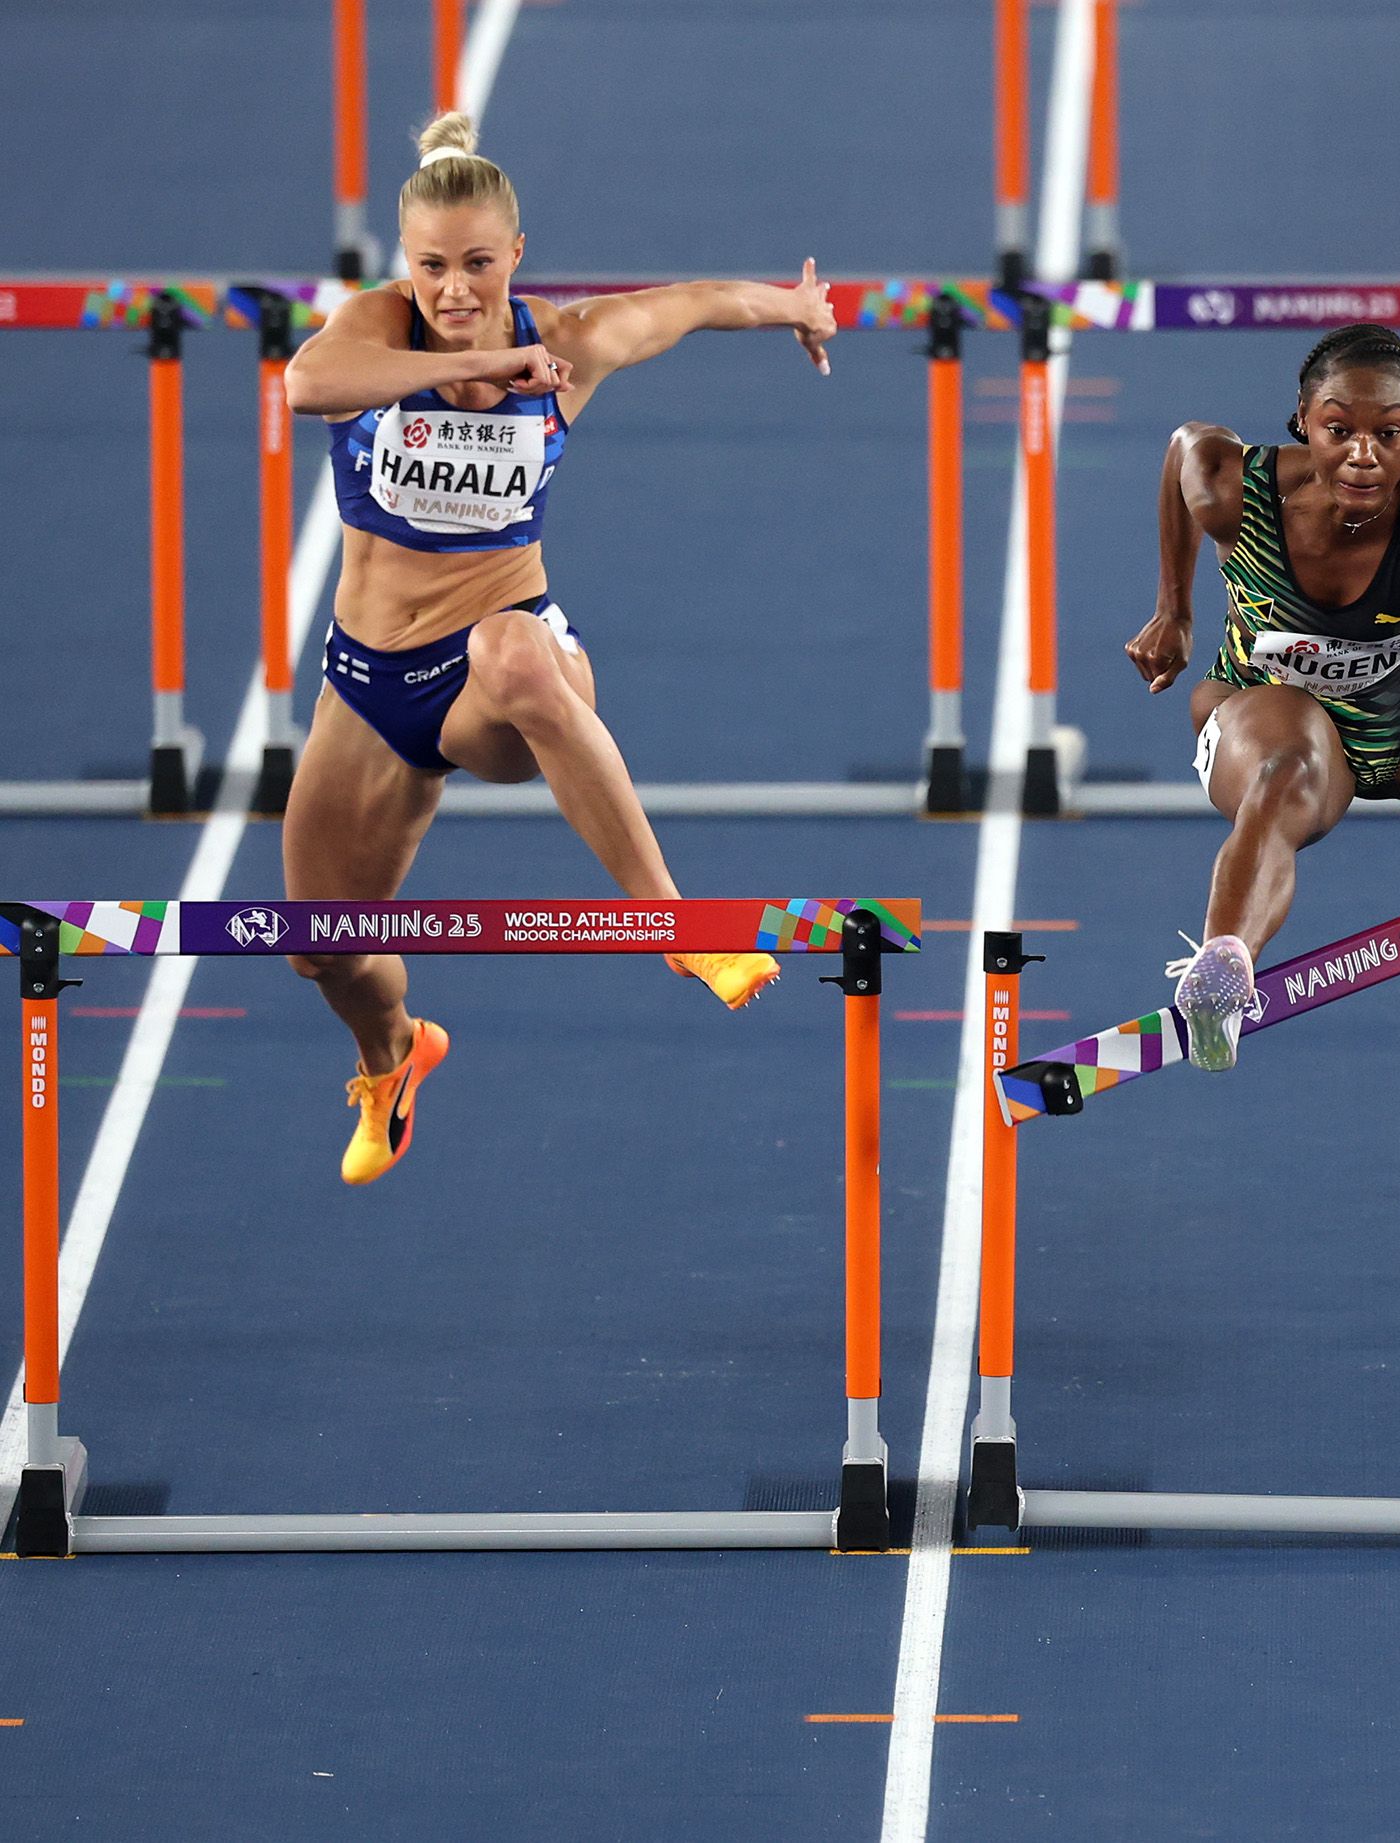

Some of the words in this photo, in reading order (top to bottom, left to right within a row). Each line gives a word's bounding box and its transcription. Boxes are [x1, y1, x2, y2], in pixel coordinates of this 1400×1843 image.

[437, 442, 460, 450] BANK
[477, 445, 514, 454] NANJING
[381, 448, 527, 498] HARALA
[413, 498, 500, 520] NANJING
[310, 909, 442, 944] NANJING
[447, 913, 482, 937] 25
[504, 912, 572, 927] WORLD
[575, 911, 676, 927] ATHLETICS
[504, 929, 558, 941] INDOOR
[561, 929, 676, 941] CHAMPIONSHIPS
[1284, 938, 1398, 1005] NANJING
[30, 1032, 48, 1108] MONDO
